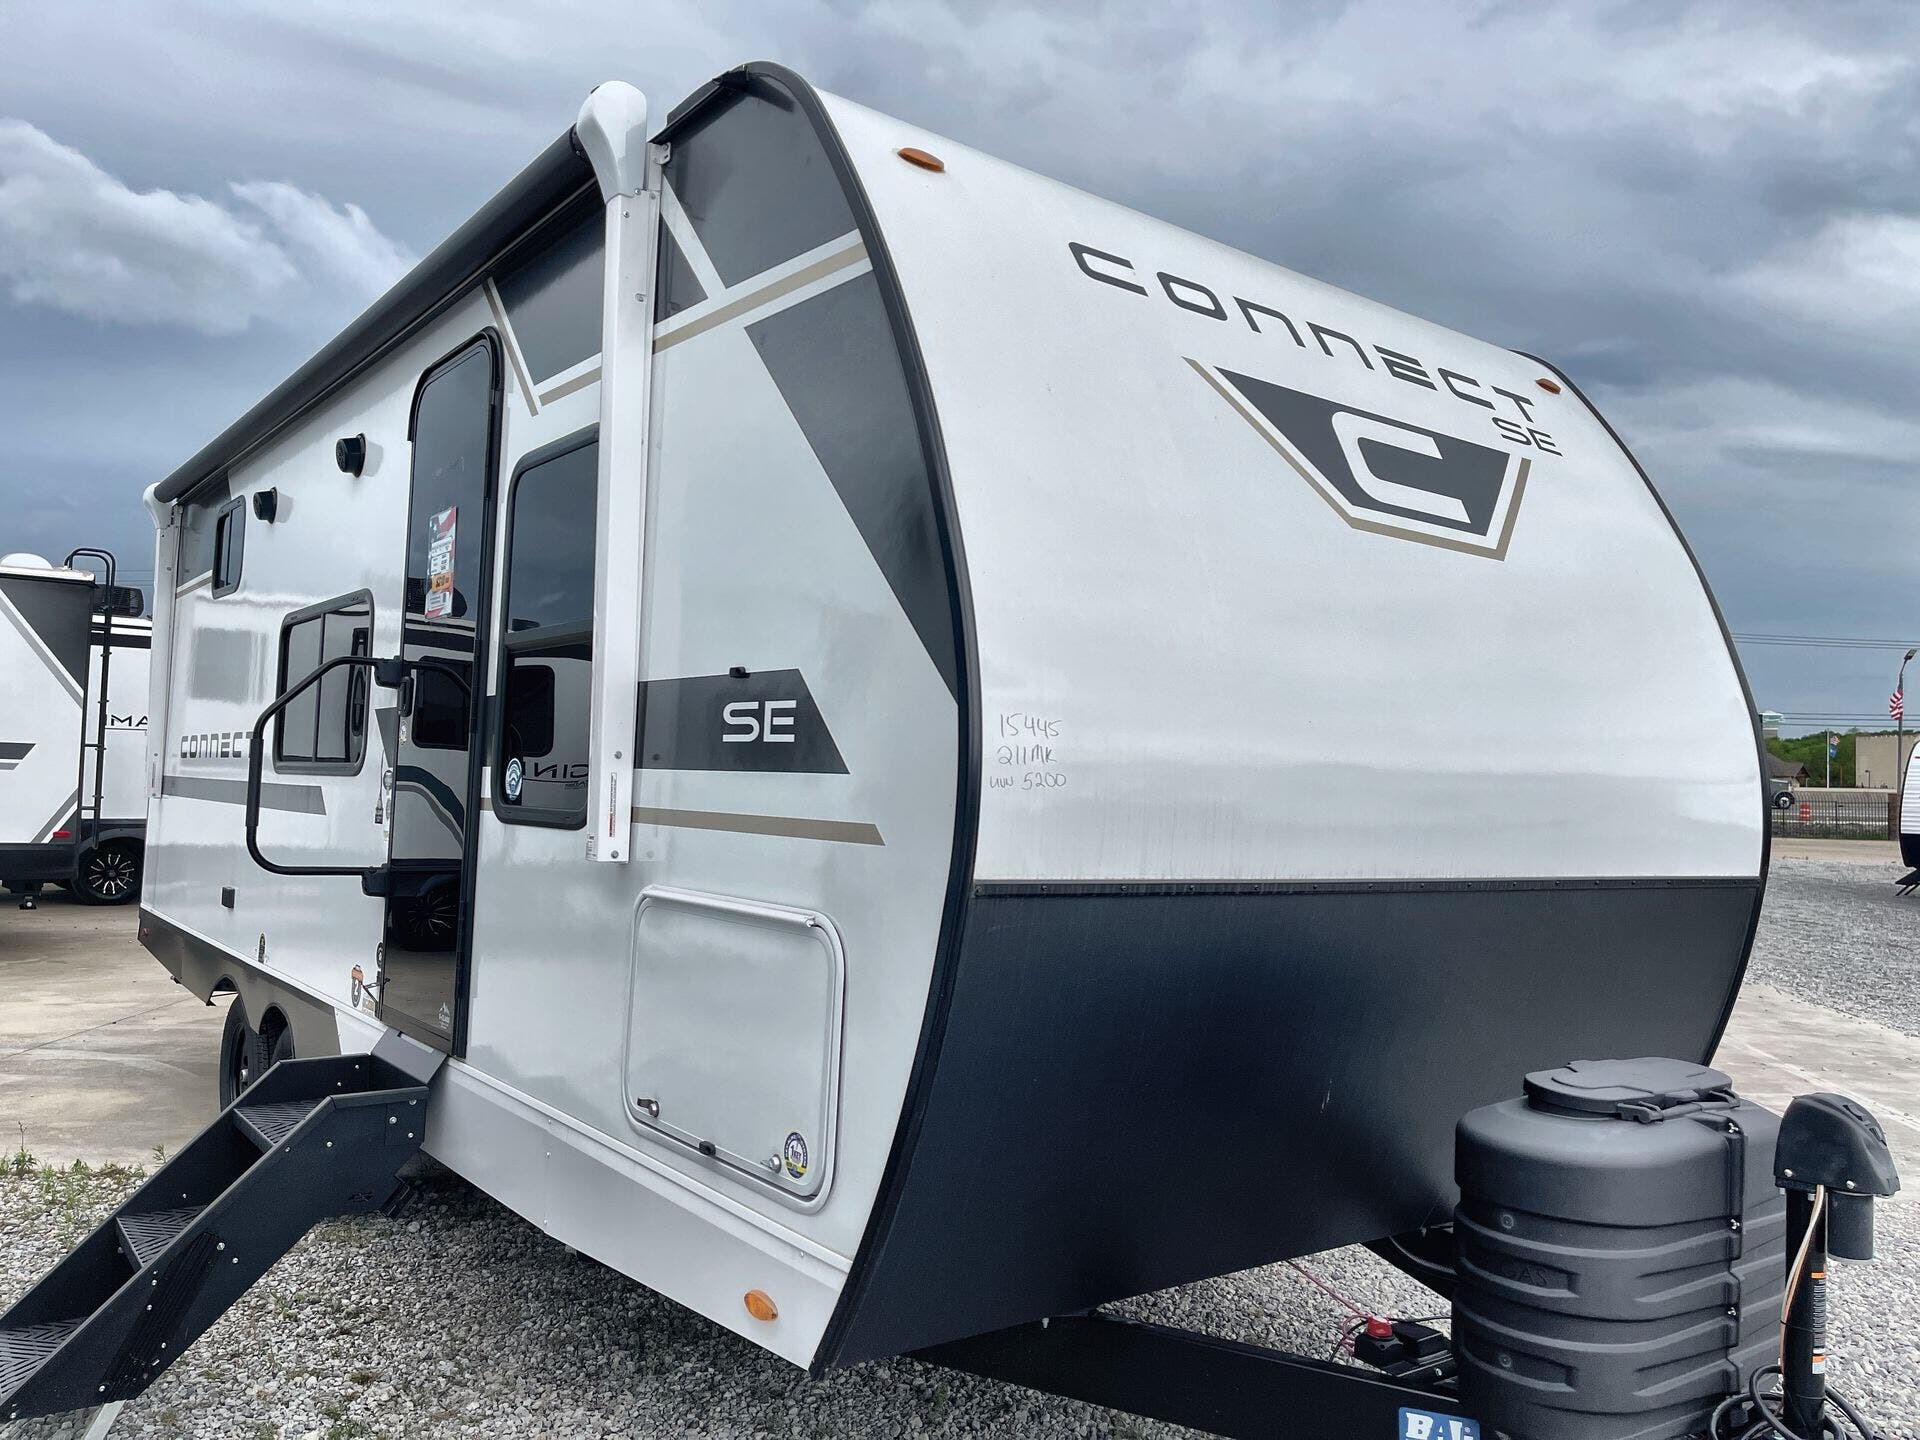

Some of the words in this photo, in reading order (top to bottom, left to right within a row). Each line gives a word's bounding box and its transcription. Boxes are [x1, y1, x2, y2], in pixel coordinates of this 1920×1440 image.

[1068, 241, 1536, 424] CONNECT
[1491, 416, 1564, 457] SE
[721, 699, 798, 743] SE
[999, 712, 1064, 739] 15445
[1021, 770, 1068, 791] 5200
